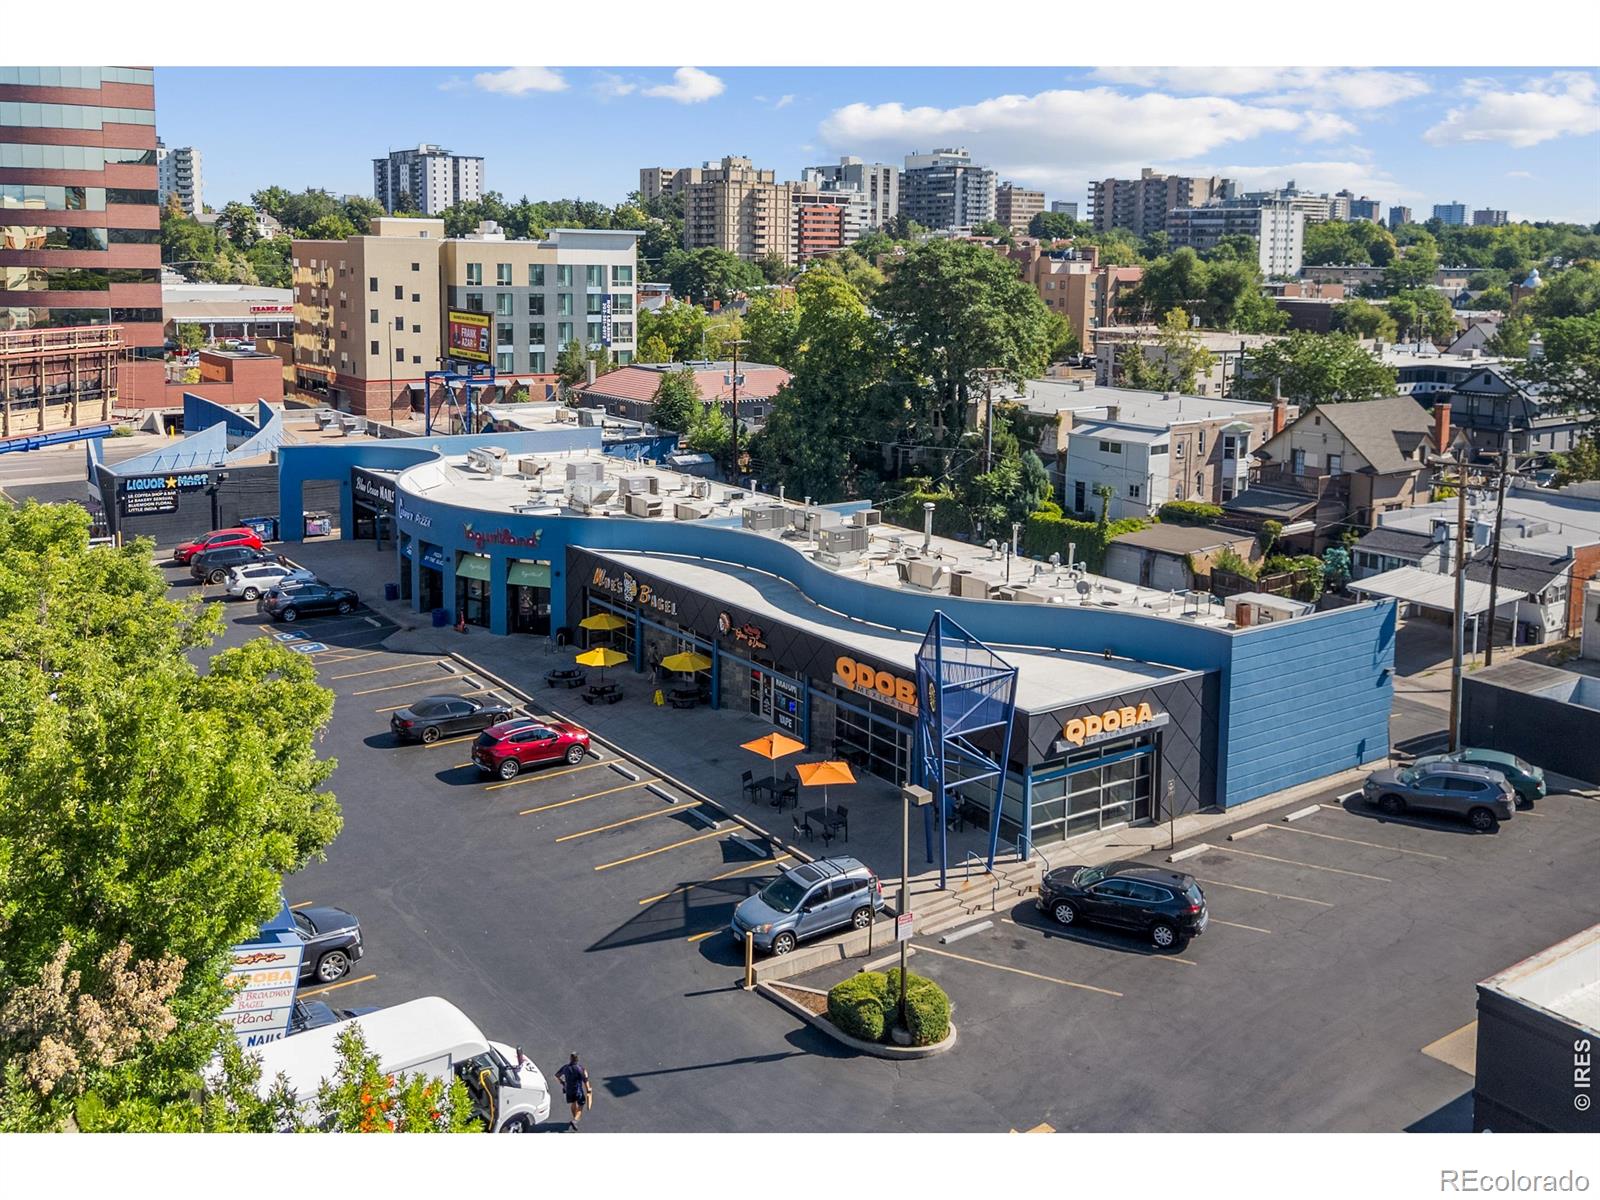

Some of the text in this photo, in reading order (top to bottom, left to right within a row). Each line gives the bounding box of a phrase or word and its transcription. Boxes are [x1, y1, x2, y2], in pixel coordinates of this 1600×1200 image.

[461, 327, 477, 338] FRANK
[126, 473, 209, 491] LIQUOR MART
[355, 476, 366, 492] Blue
[379, 486, 395, 504] NAILS
[835, 656, 918, 706] QDOB
[1063, 702, 1153, 747] QDOBA
[246, 989, 292, 1001] BROADWAY
[238, 1000, 265, 1010] BAGEL
